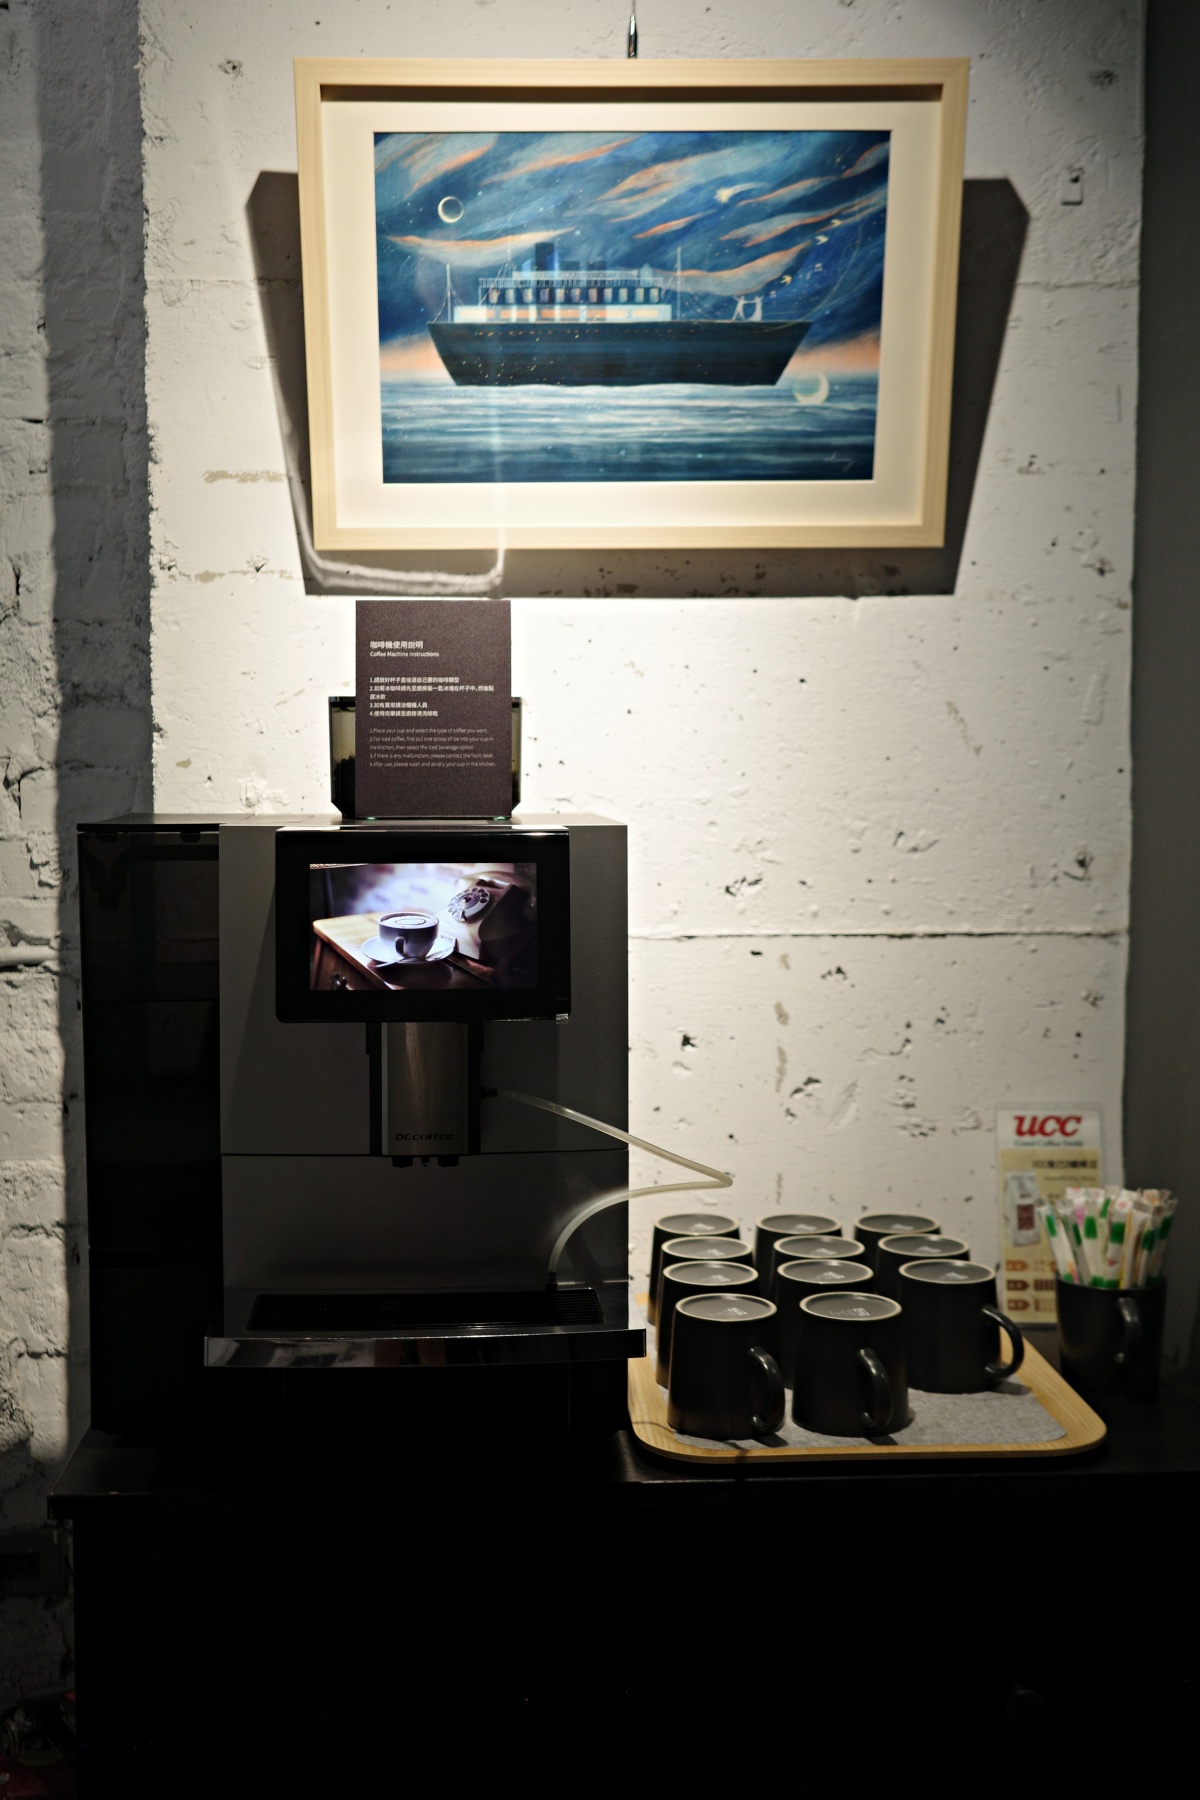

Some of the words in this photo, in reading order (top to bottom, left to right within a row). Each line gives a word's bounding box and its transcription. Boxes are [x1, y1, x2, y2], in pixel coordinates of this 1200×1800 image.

[370, 641, 424, 649] 咖啡機使用說明
[396, 1133, 454, 1141] Dr.coffee
